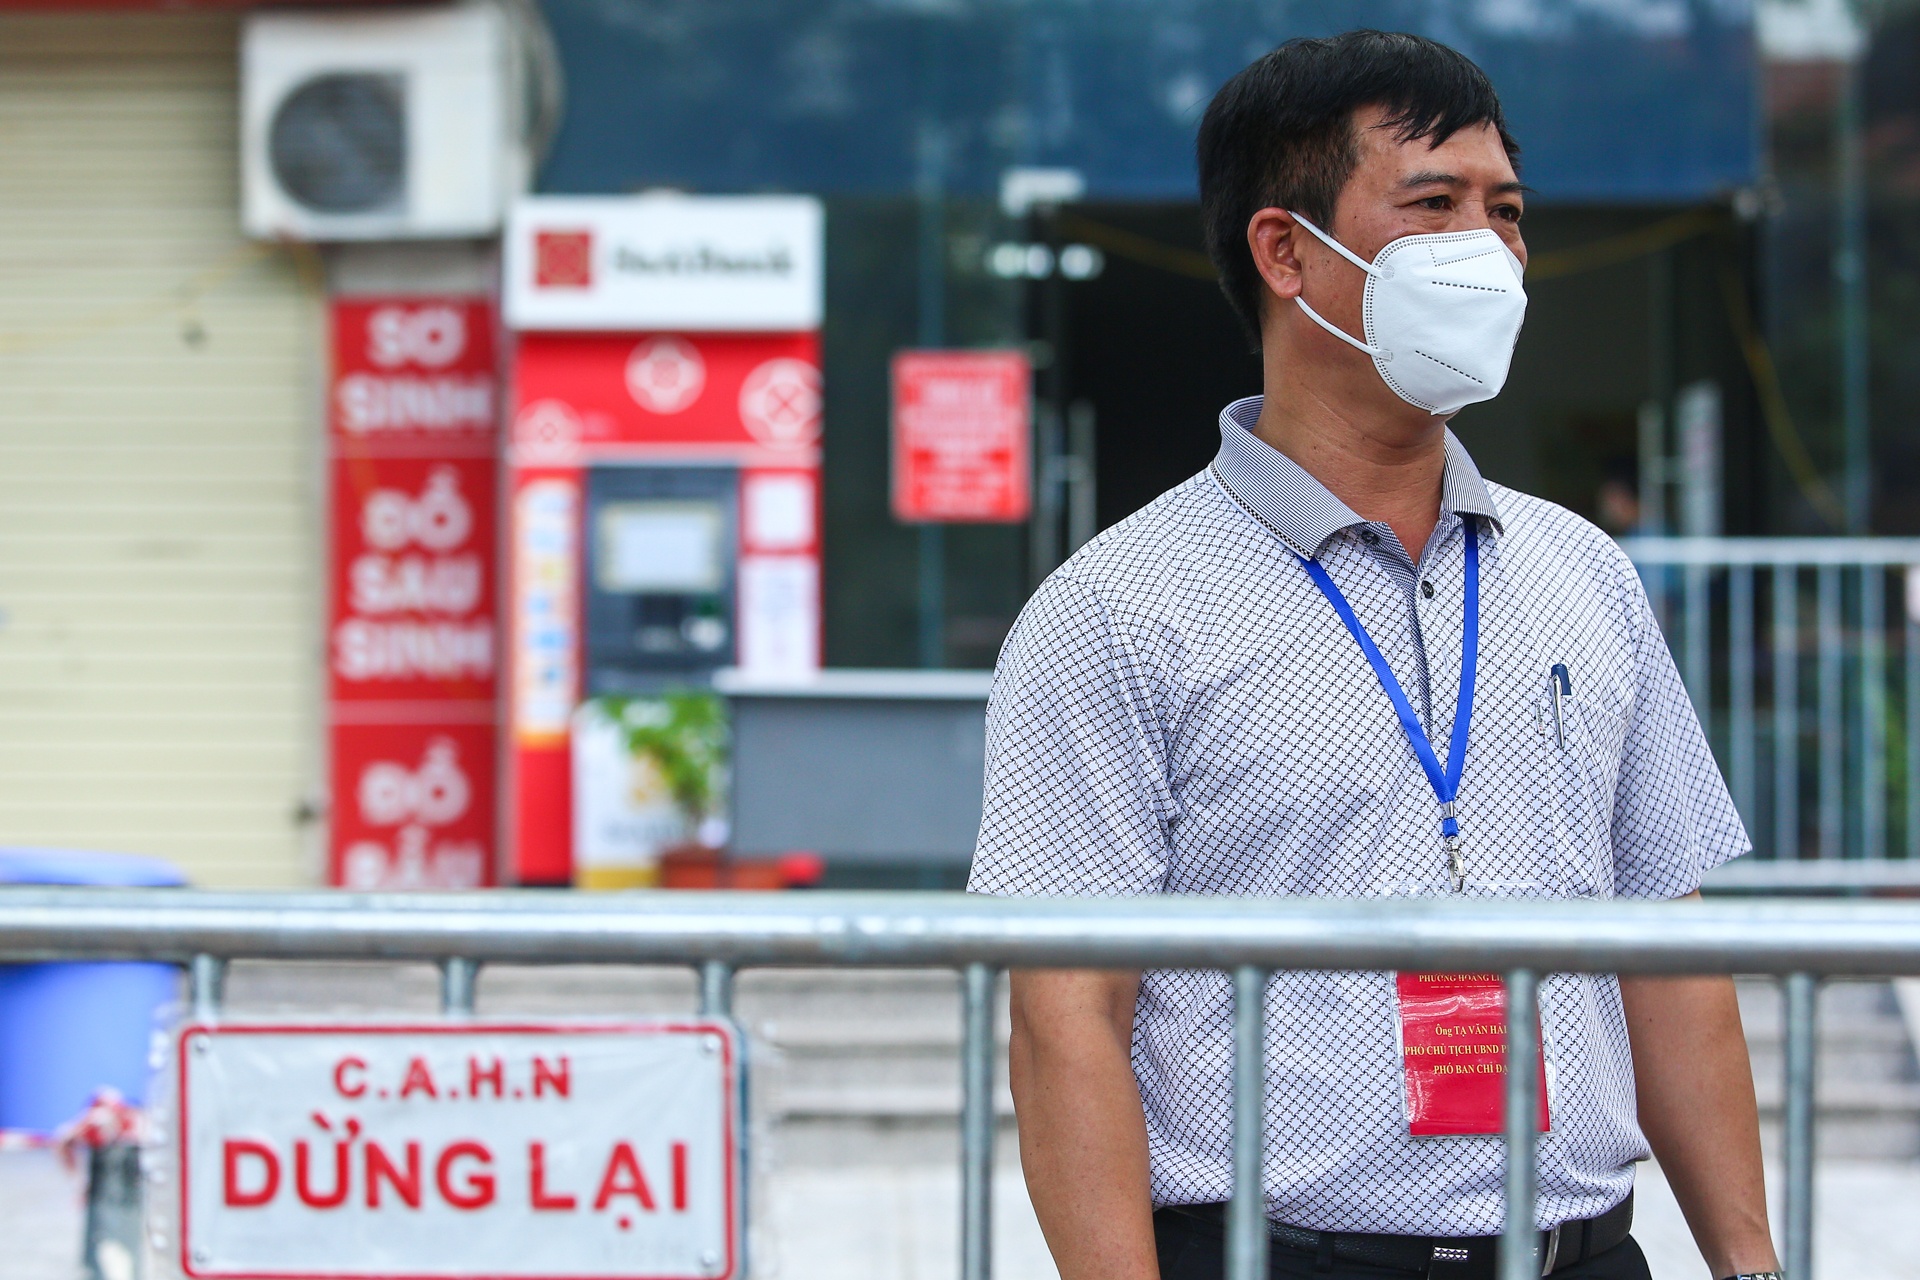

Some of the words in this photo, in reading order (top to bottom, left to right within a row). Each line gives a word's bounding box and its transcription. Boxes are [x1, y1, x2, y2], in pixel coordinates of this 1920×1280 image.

[343, 376, 490, 431] SINH
[353, 557, 479, 612] SAU
[340, 619, 491, 678] SINH
[1405, 1044, 1425, 1056] PHÓ
[1426, 1043, 1447, 1056] CHỦ
[1448, 1045, 1472, 1057] TỊCH
[1474, 1044, 1499, 1054] UBND
[1435, 1023, 1453, 1038] Ông
[1454, 1025, 1467, 1037] TẠ
[1468, 1023, 1488, 1035] VĂN
[334, 1056, 572, 1099] C.A.H.N
[1434, 1062, 1454, 1075] PHÓ
[1455, 1064, 1475, 1074] BAN
[223, 1113, 498, 1210] DỪNG
[529, 1140, 688, 1231] LẠI
